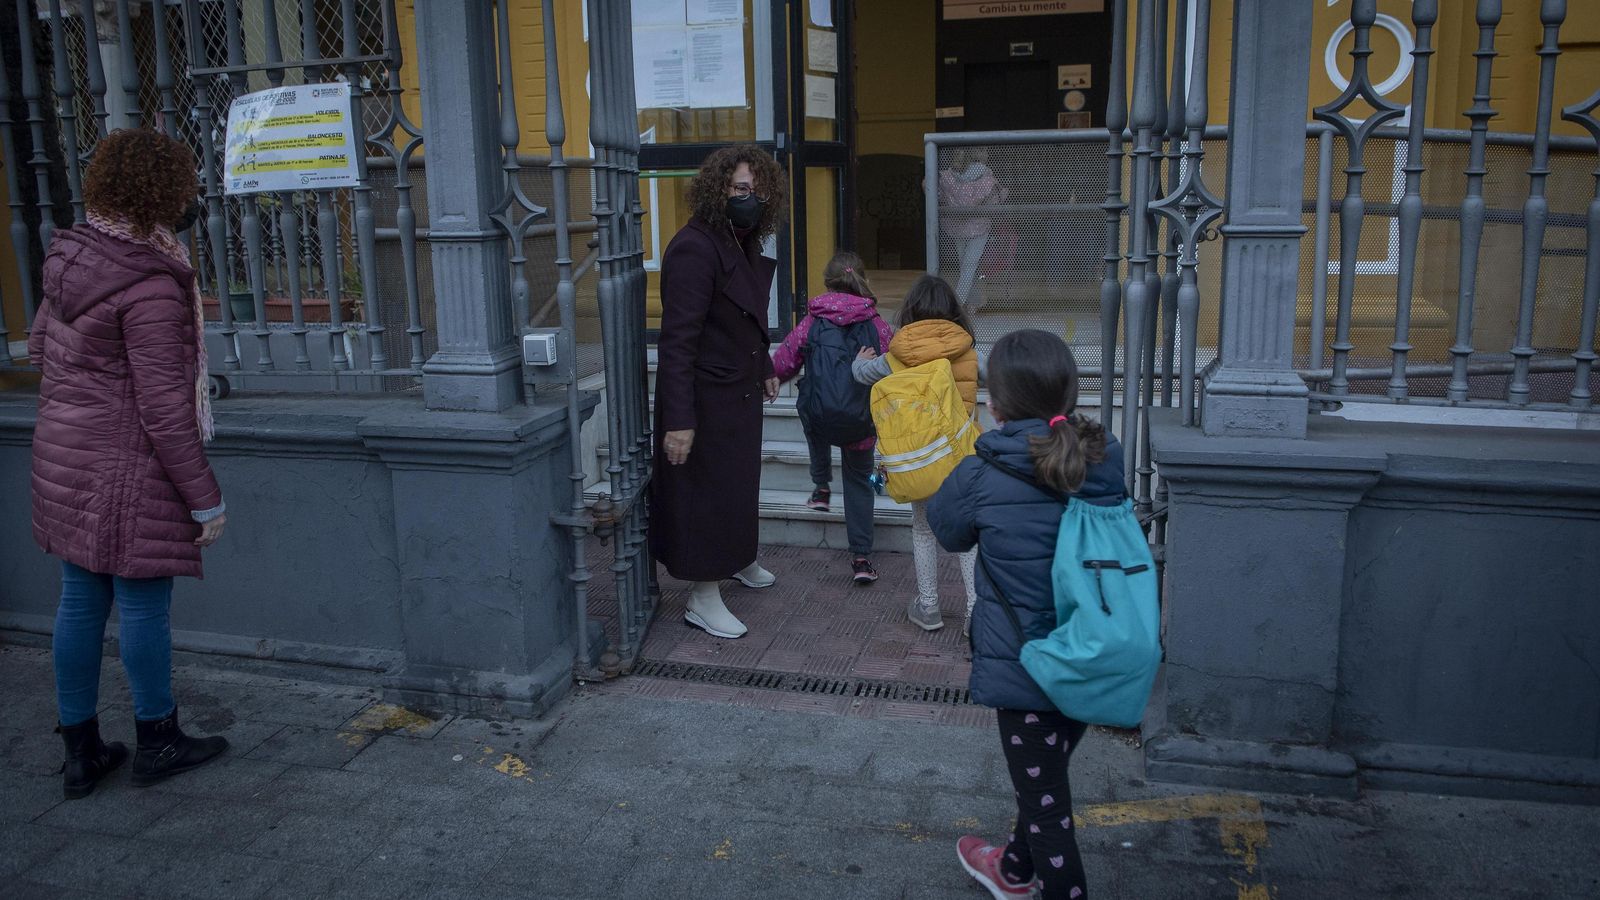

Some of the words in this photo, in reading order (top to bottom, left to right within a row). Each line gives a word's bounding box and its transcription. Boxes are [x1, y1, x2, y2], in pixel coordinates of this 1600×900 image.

[979, 4, 1017, 14] Cambia
[1019, 4, 1030, 12] tu
[1032, 2, 1066, 11] mente
